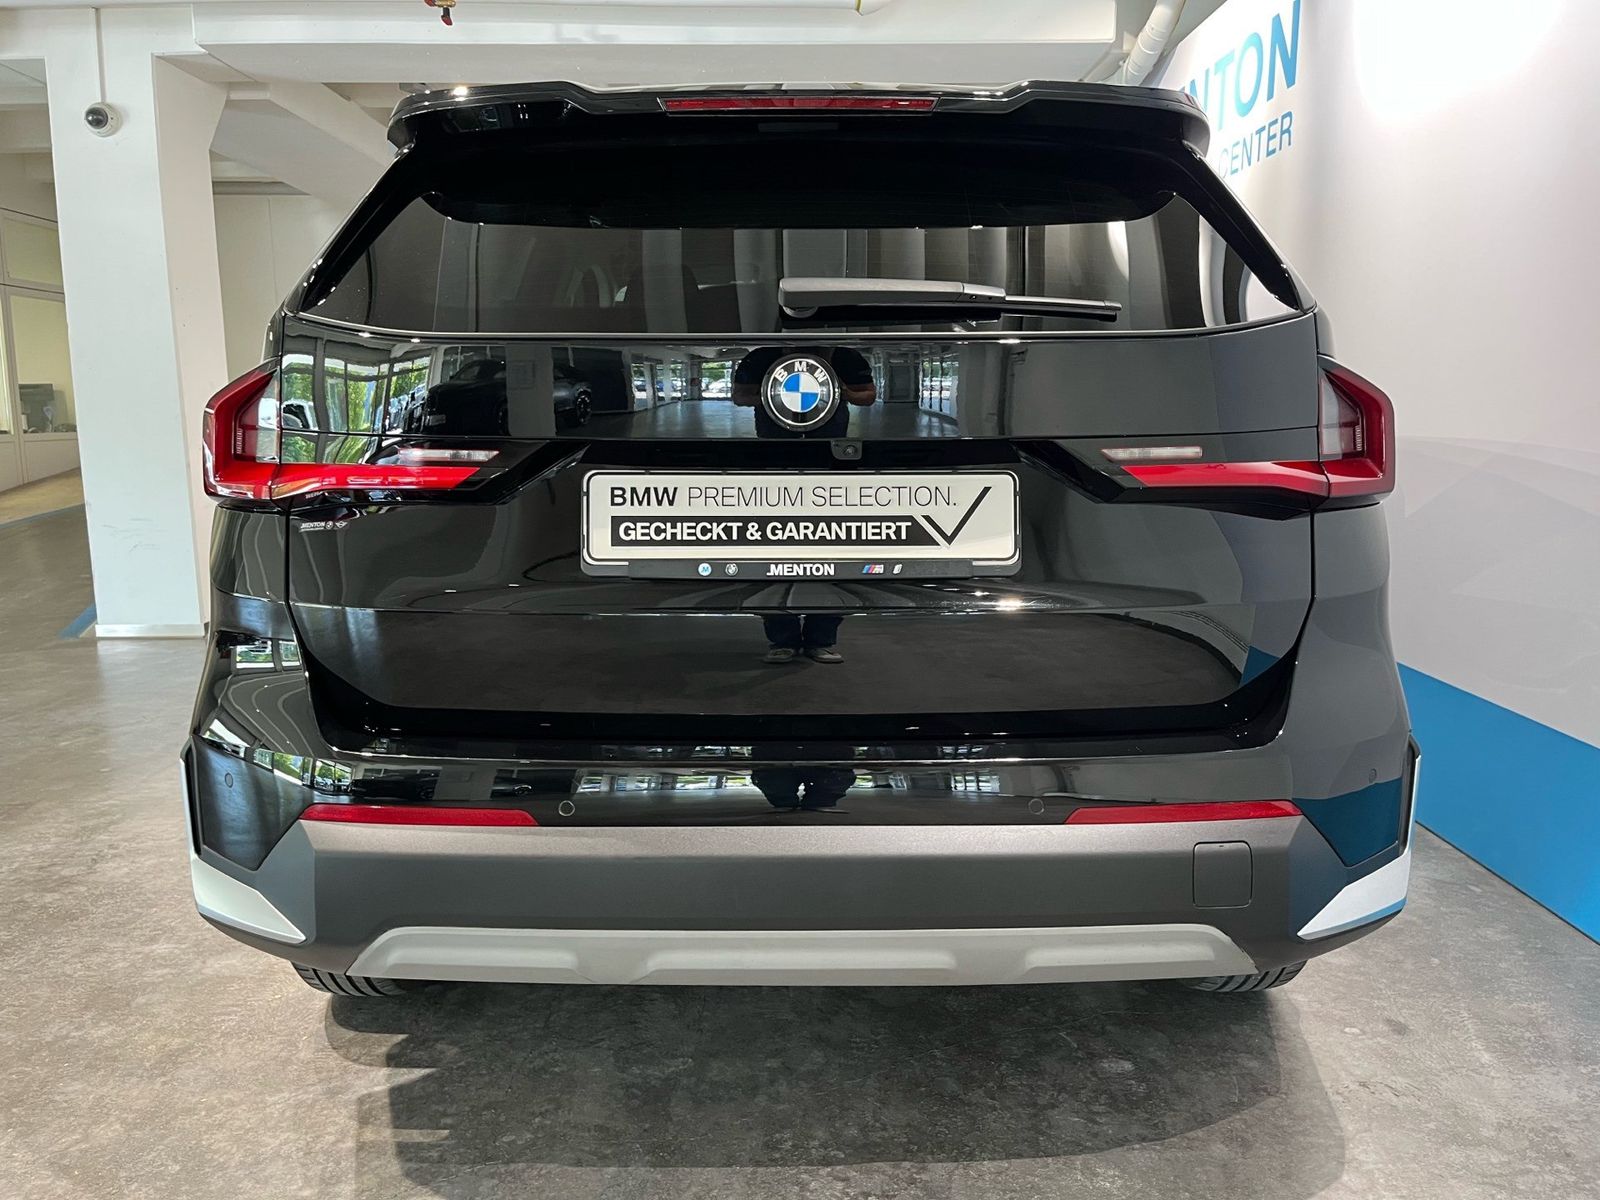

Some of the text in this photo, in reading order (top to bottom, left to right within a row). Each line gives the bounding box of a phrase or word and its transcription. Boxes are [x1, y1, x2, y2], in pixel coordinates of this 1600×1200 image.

[774, 361, 827, 383] BMW
[609, 485, 957, 507] BMW PREMIUM SELECTION.
[618, 521, 912, 541] GECHECKT & GARANTIERT
